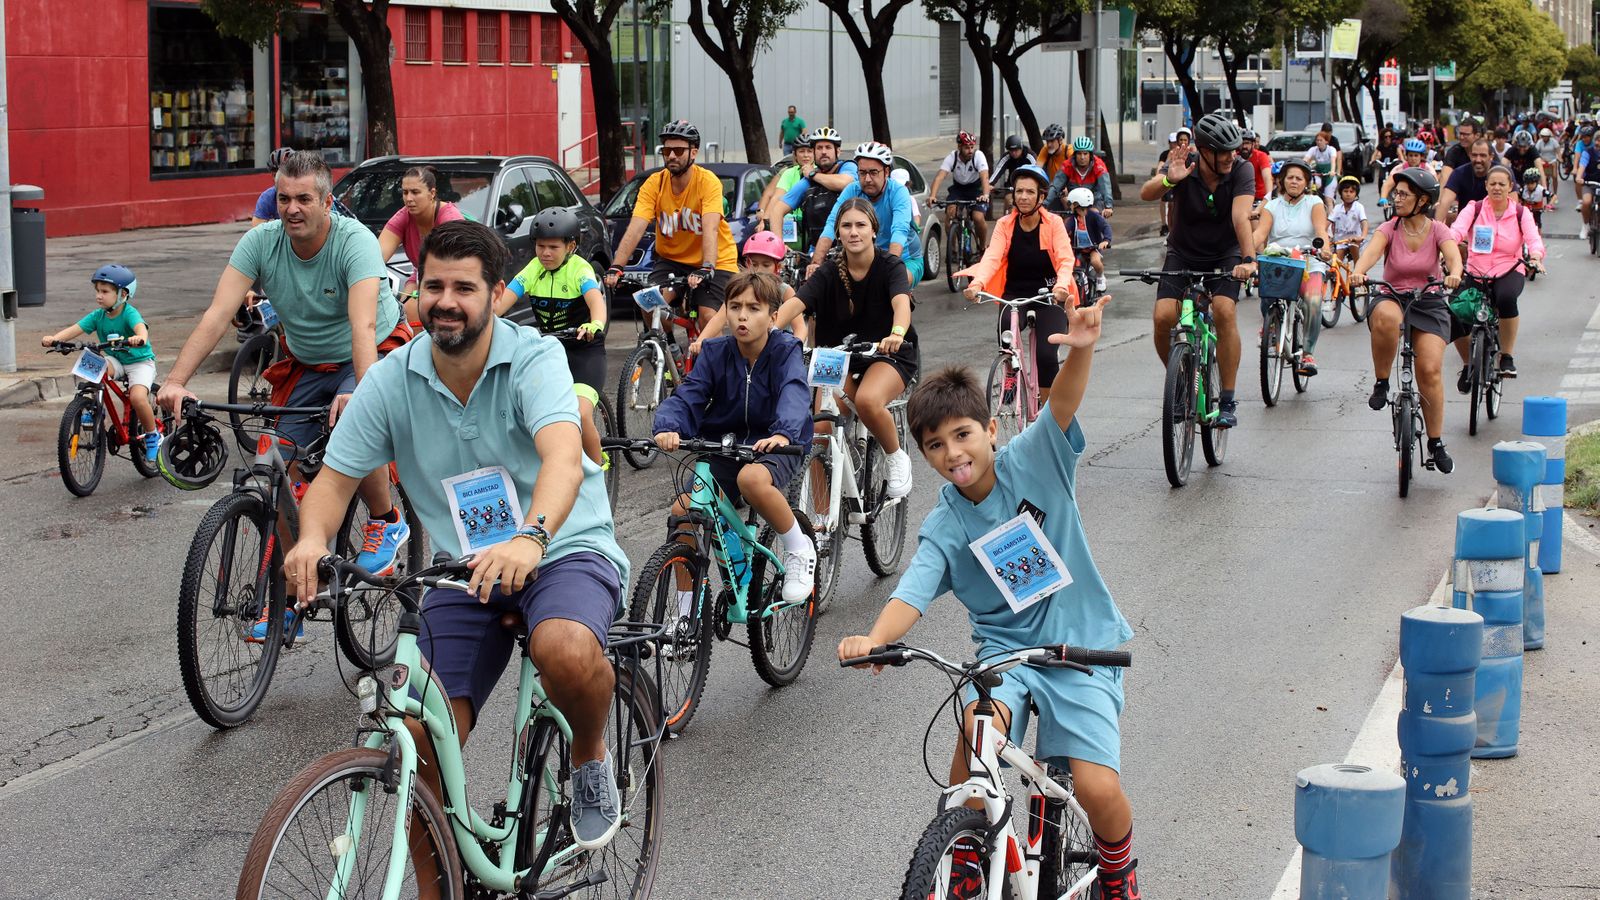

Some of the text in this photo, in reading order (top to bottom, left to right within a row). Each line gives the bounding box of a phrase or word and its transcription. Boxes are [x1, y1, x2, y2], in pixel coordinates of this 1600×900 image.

[660, 206, 703, 238] NIKE
[474, 483, 499, 495] AMISTAD
[993, 547, 1004, 557] BICI
[1004, 534, 1028, 551] AMISTAD
